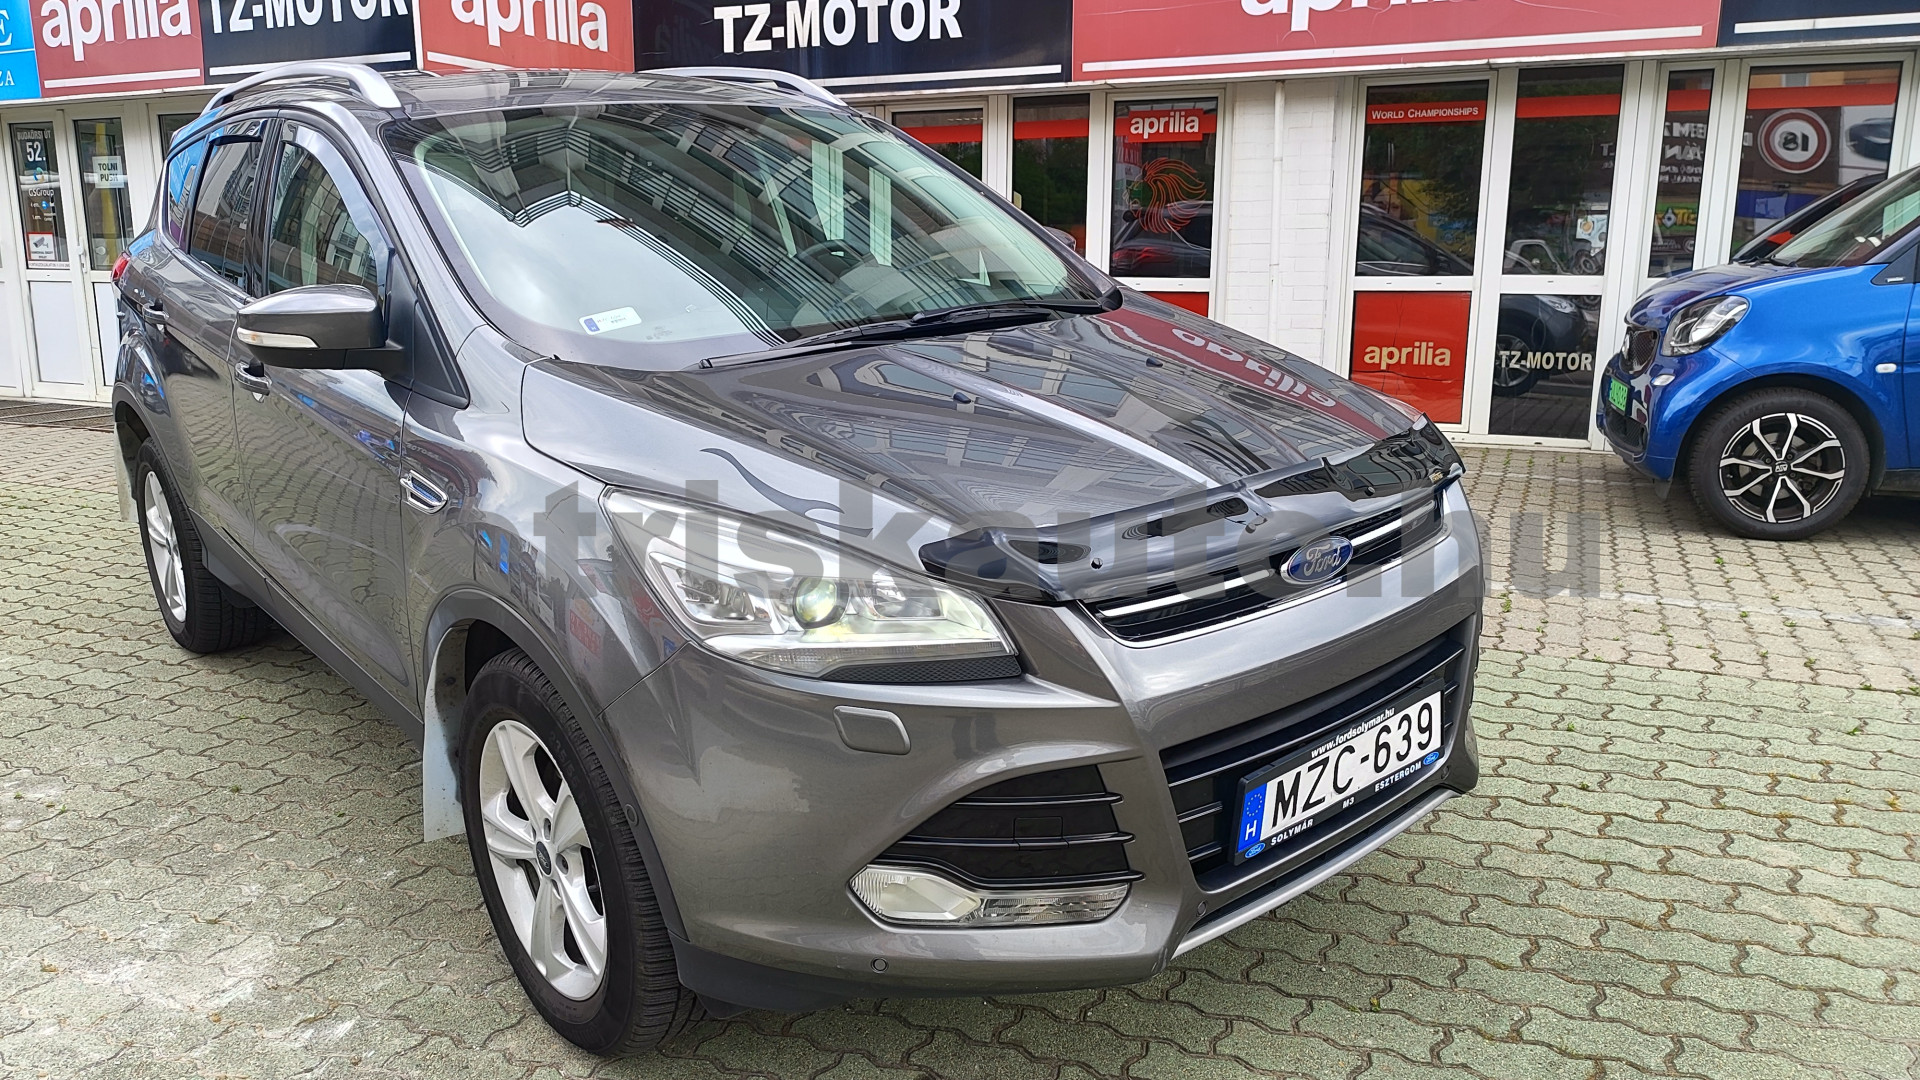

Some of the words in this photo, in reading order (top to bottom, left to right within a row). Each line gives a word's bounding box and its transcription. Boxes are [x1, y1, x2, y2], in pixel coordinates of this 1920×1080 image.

[41, 0, 191, 61] aprilia
[451, 0, 608, 52] aprilia
[713, 0, 963, 53] TZ-MOTOR
[1130, 111, 1199, 139] aprilia
[98, 162, 118, 171] TOLNI
[1363, 342, 1451, 370] aprilia
[1500, 350, 1593, 371] TZ-MOTOR
[1303, 543, 1342, 577] Ford
[1311, 707, 1395, 758] www.fordsolymar.hu
[1271, 702, 1434, 829] MZC-639
[1271, 818, 1313, 845] SOLYMÁR
[1343, 797, 1355, 809] M3
[1375, 761, 1422, 792] ESZTERGOM
[1245, 820, 1257, 840] H
